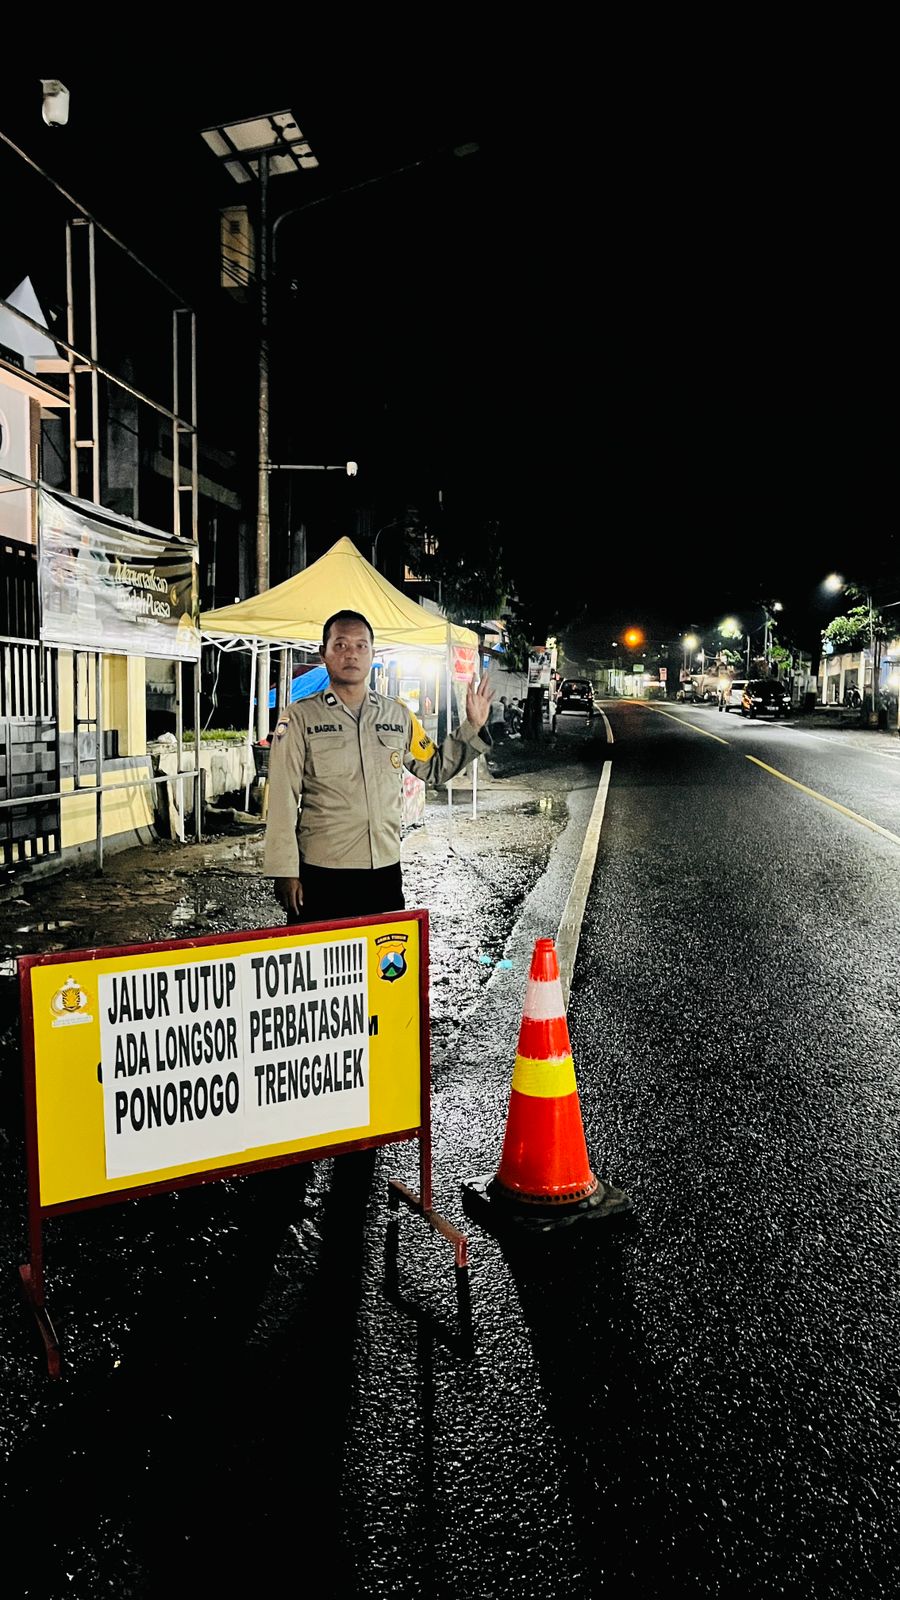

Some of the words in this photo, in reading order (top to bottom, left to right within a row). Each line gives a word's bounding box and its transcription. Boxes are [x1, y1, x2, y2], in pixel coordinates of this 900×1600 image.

[146, 593, 171, 617] Puasa
[375, 723, 404, 733] POLRI
[108, 971, 170, 1025] JALUR
[175, 962, 236, 1014] TUTUP
[251, 951, 317, 1000] TOTAL
[114, 1031, 151, 1079] ADA
[155, 1017, 238, 1072] LONGSOR
[250, 993, 364, 1054] PERBATASAN
[115, 1071, 240, 1135] PONOROGO
[254, 1048, 365, 1107] TRENGGALEK
